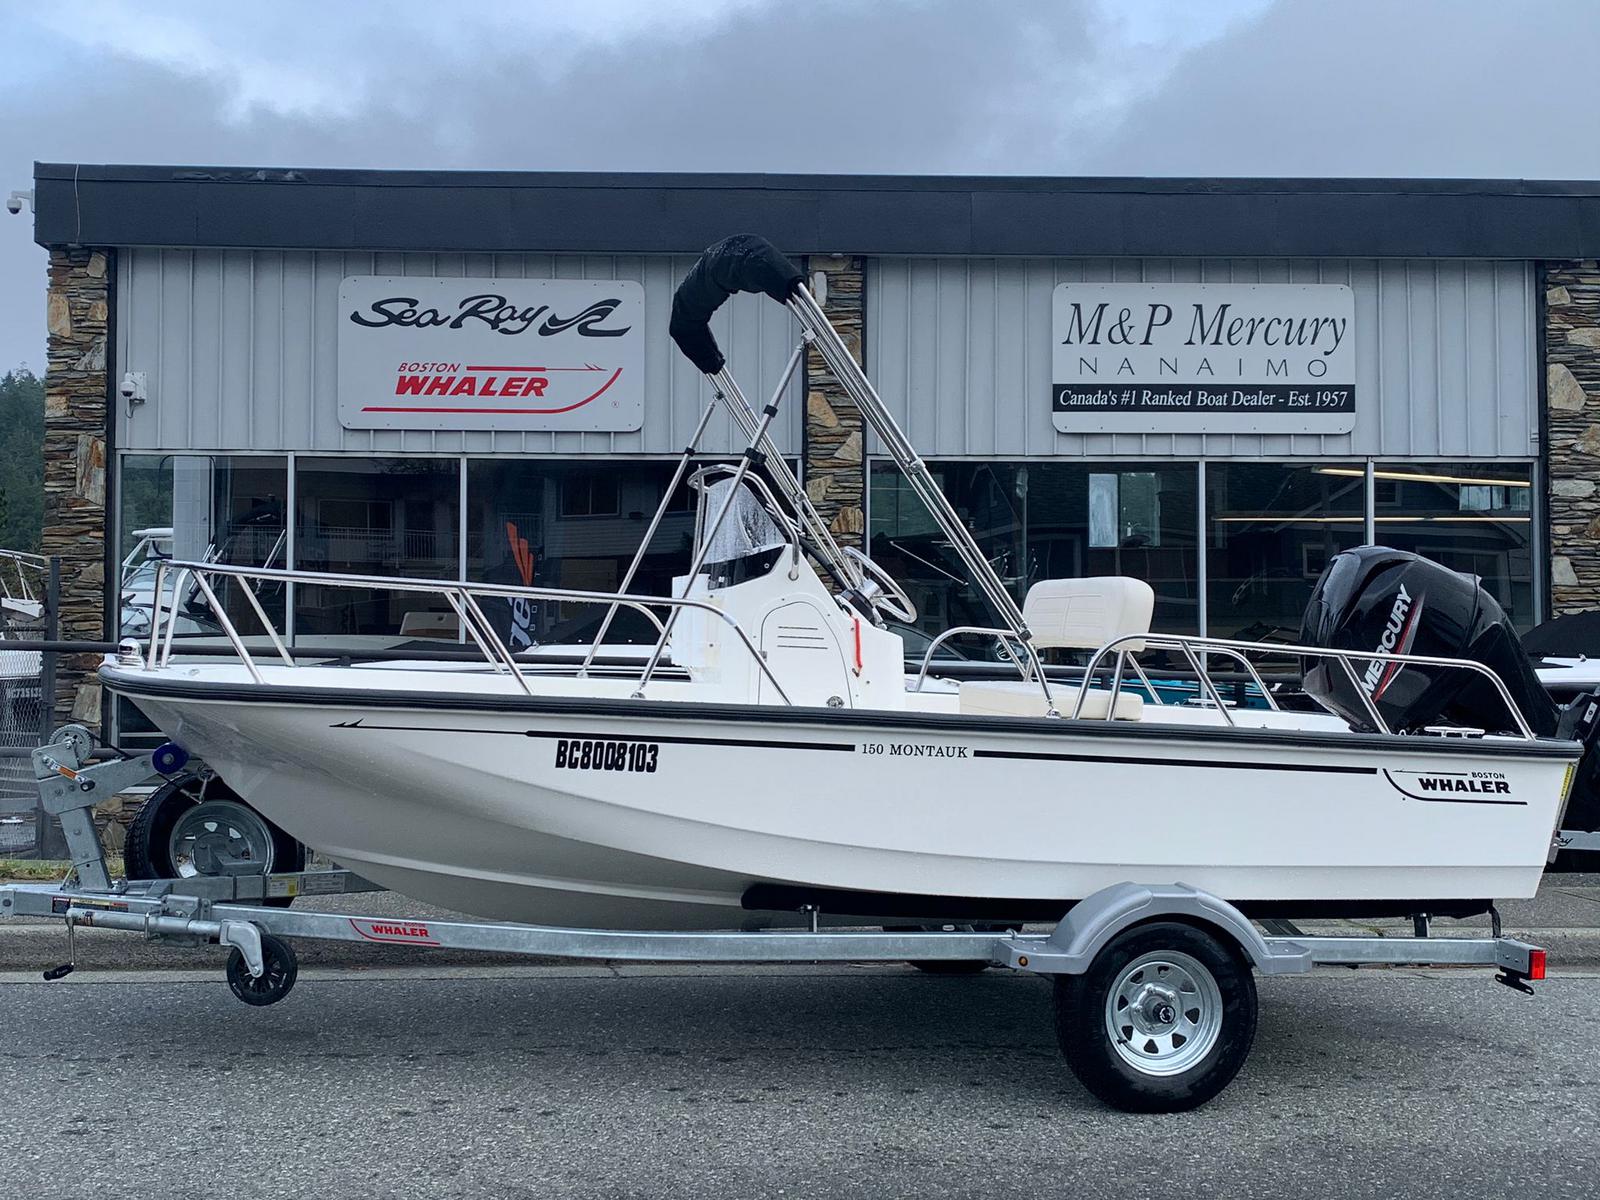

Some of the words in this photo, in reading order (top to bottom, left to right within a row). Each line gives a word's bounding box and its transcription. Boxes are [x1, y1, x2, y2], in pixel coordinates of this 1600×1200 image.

[350, 297, 451, 328] Sea
[449, 294, 550, 336] Ray
[1061, 302, 1174, 347] M&P
[1183, 303, 1347, 356] Mercury
[398, 362, 461, 373] BOSTON
[1079, 357, 1328, 378] NANAIMO
[395, 375, 549, 398] WHALER
[1059, 389, 1118, 406] Canada's
[1120, 391, 1137, 405] #1
[1141, 389, 1192, 407] Ranked
[1196, 390, 1229, 407] Boat
[1231, 390, 1277, 407] Dealer
[1288, 391, 1313, 407] Est.
[1315, 390, 1348, 408] 1957
[1361, 583, 1412, 698] MERCURY
[555, 739, 659, 773] BC8008103
[861, 743, 884, 755] 150
[889, 743, 968, 758] MONTAUK
[1471, 771, 1506, 780] BOSTON
[1418, 778, 1512, 794] WHALER
[371, 924, 430, 938] WHALER
